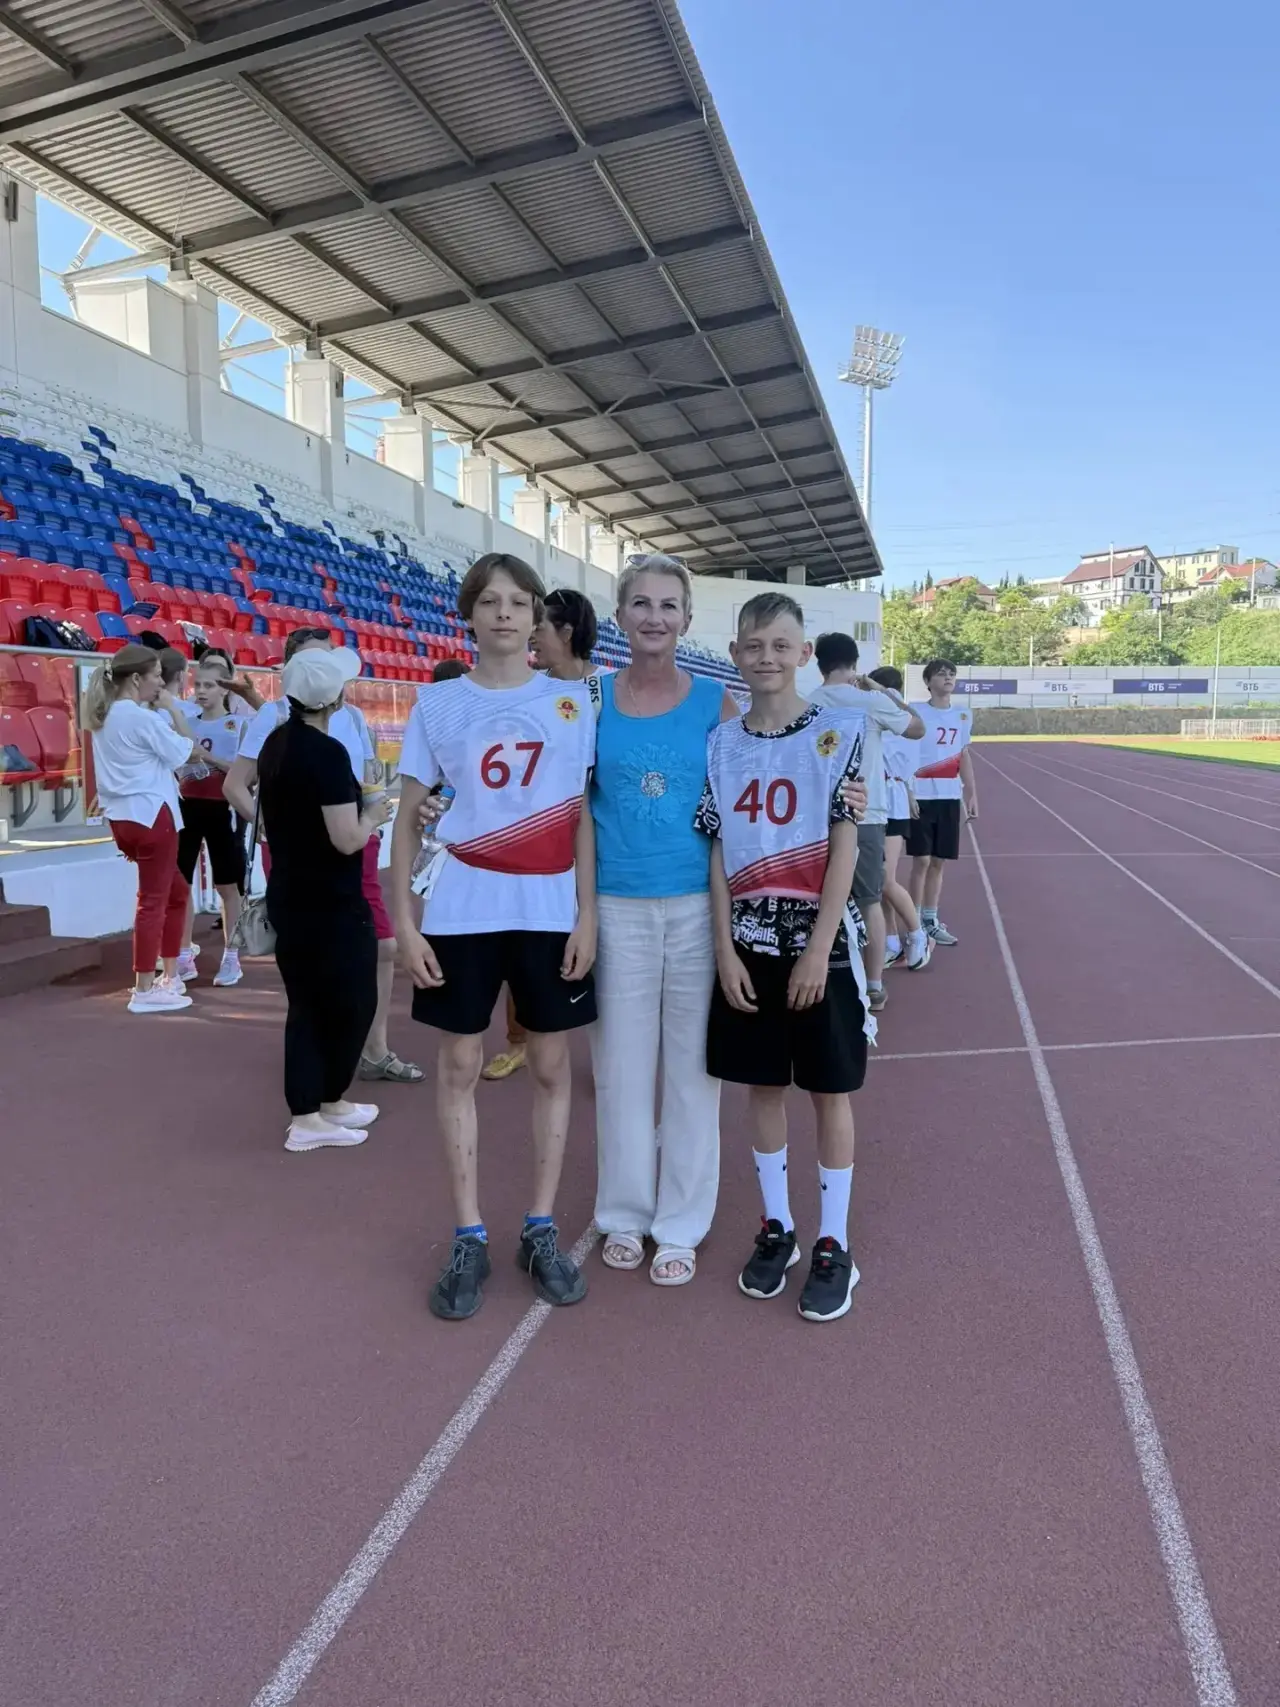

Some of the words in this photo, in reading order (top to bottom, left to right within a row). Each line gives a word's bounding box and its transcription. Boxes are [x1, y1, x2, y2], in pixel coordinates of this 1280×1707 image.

[964, 683, 979, 692] ВТБ
[1051, 683, 1068, 692] ВТБ
[1148, 682, 1165, 691] ВТБ
[1243, 682, 1259, 691] ВТБ
[936, 727, 958, 745] 27
[480, 741, 544, 789] 67
[733, 778, 797, 825] 40
